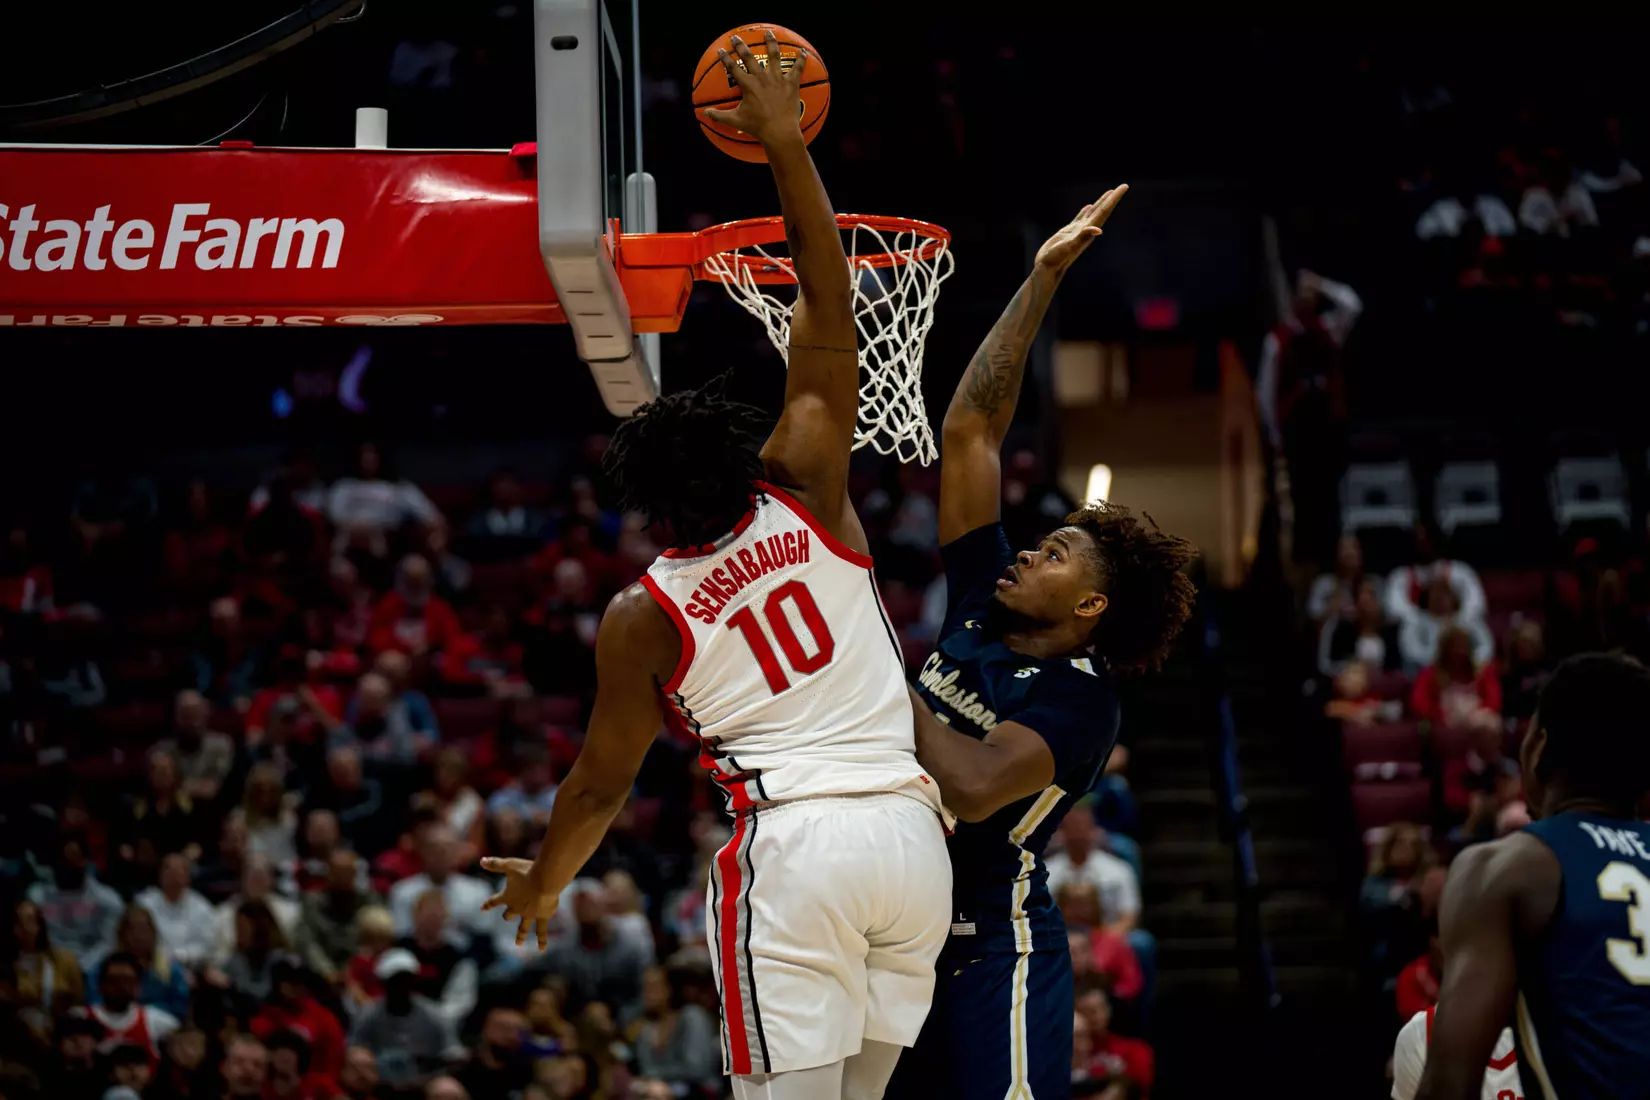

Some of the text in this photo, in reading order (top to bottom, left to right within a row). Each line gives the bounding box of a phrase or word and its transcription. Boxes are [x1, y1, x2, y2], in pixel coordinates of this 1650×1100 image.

[0, 202, 345, 272] tate Farm
[0, 314, 128, 328] Far
[685, 529, 810, 625] SENSABAUGH
[725, 579, 836, 697] 10
[919, 651, 998, 732] Chleston
[960, 912, 967, 921] L
